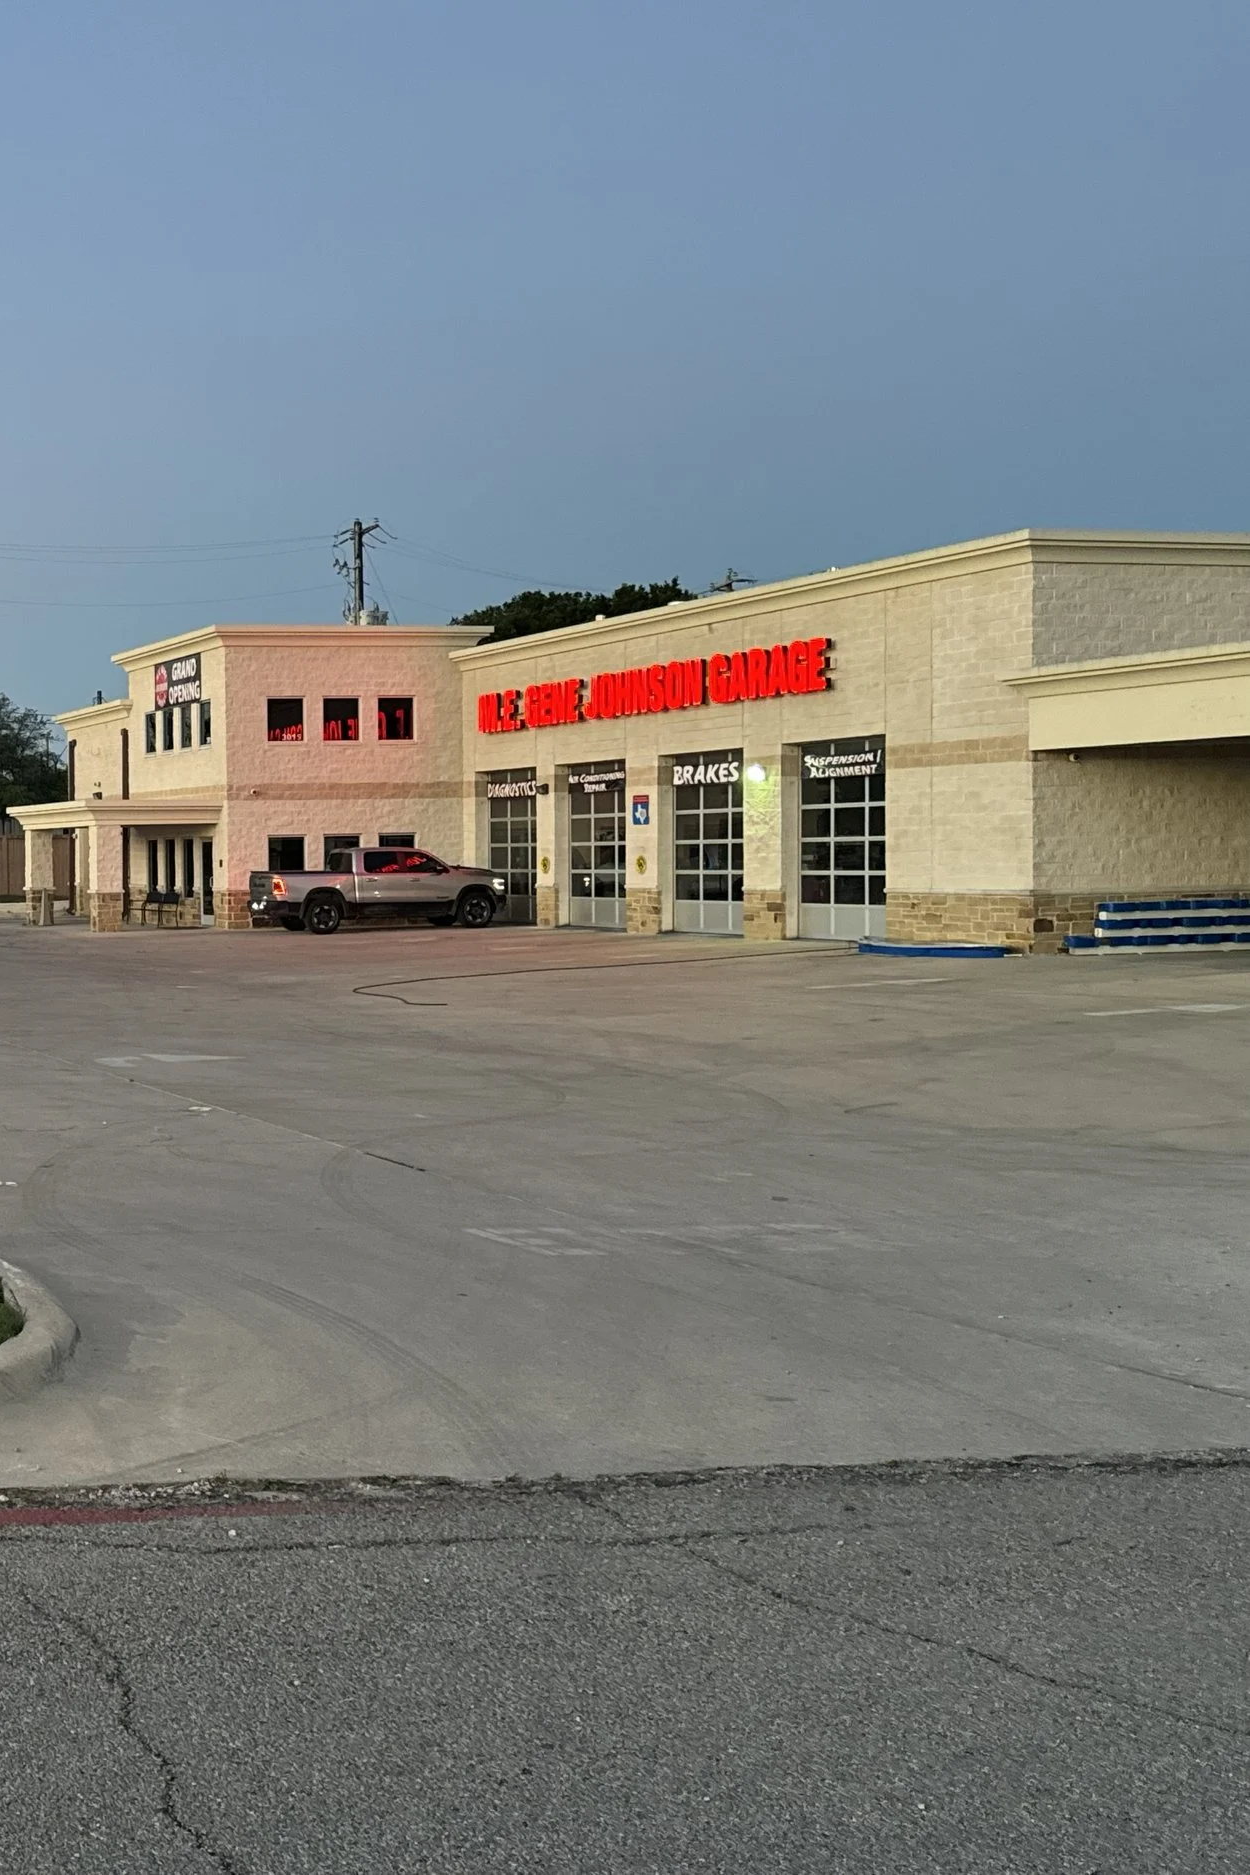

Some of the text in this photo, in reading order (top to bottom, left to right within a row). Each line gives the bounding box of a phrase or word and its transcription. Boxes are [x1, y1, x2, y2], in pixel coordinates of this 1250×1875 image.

[171, 658, 197, 681] GRAND
[168, 680, 201, 705] OPENING
[524, 679, 583, 729] GENE
[583, 658, 707, 721] JOHNSON
[708, 636, 833, 705] GARAGE
[803, 752, 875, 767] SUSPENSION
[809, 764, 878, 778] ALIGNMENT
[673, 761, 740, 787] BRAKES
[487, 780, 537, 798] DIAGNOSTICS
